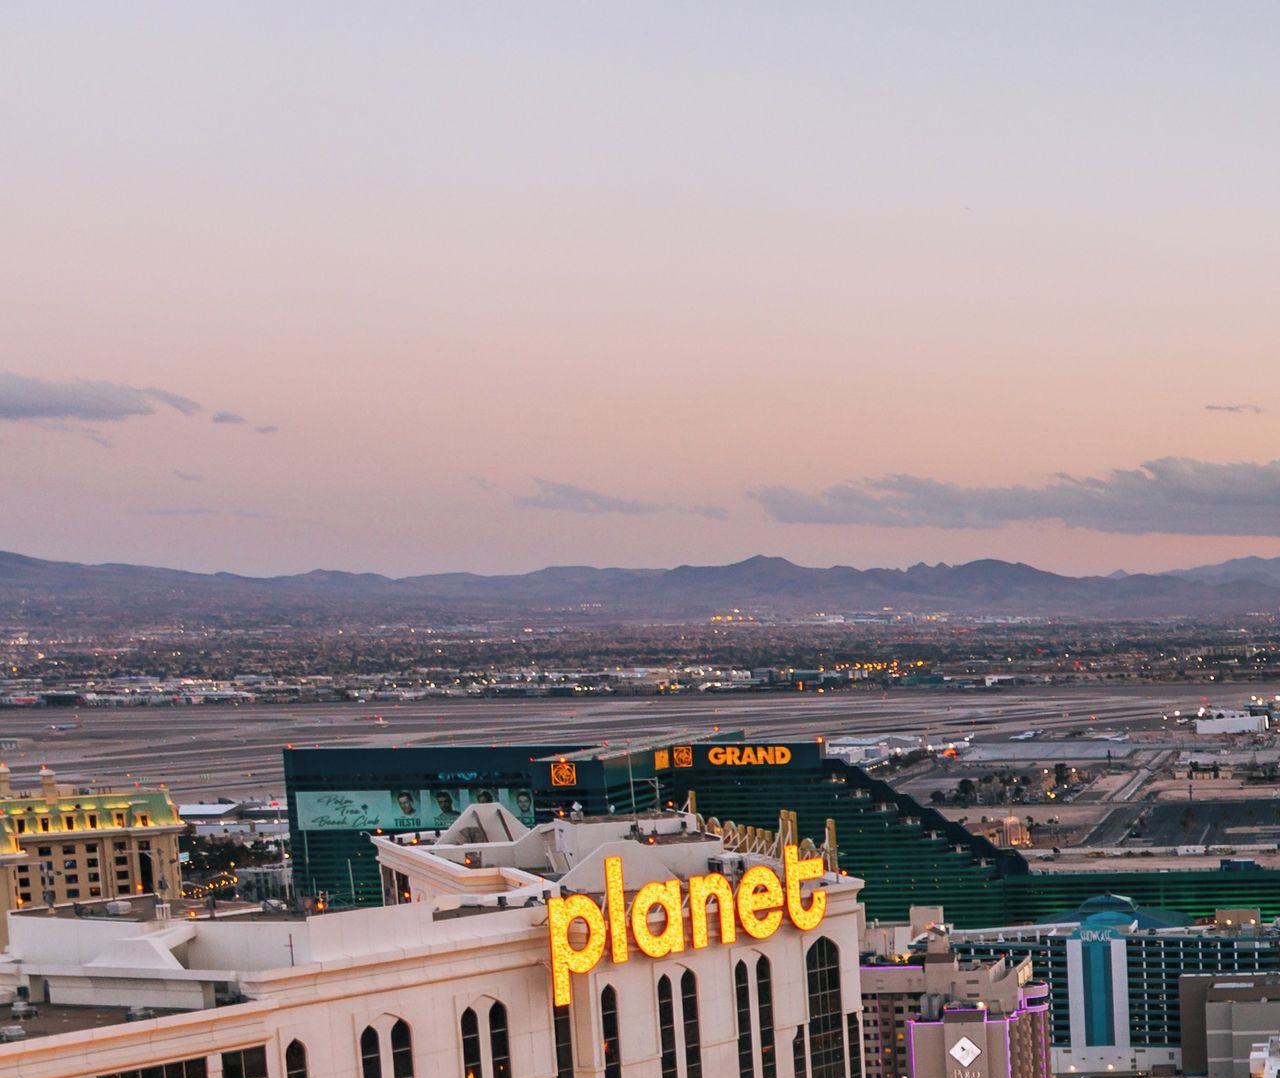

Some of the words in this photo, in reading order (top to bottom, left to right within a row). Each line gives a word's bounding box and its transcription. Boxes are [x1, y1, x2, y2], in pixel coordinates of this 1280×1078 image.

[708, 746, 792, 766] GRAND
[547, 844, 828, 1007] planet
[953, 1069, 981, 1078] POLO
